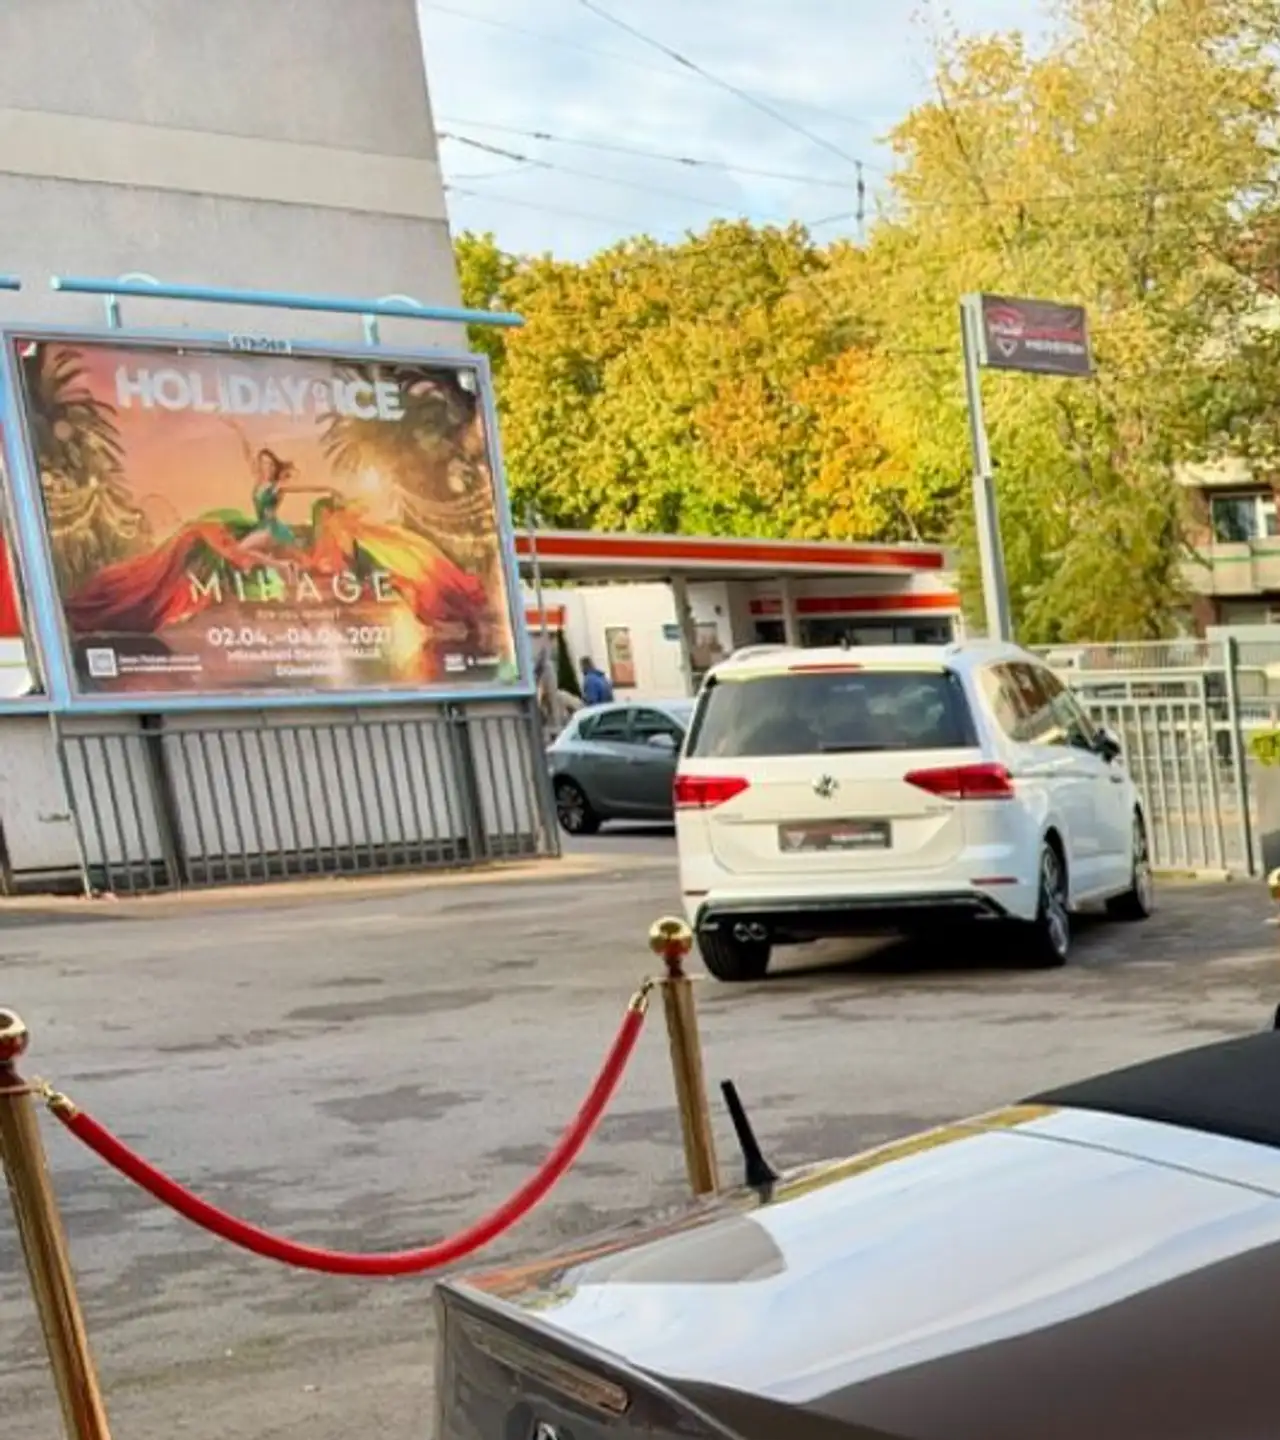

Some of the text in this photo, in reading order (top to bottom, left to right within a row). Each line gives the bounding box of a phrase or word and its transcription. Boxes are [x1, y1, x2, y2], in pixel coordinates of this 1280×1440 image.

[115, 366, 309, 414] HOLIDAY
[333, 378, 405, 420] ICE
[187, 570, 394, 604] MIRAGE
